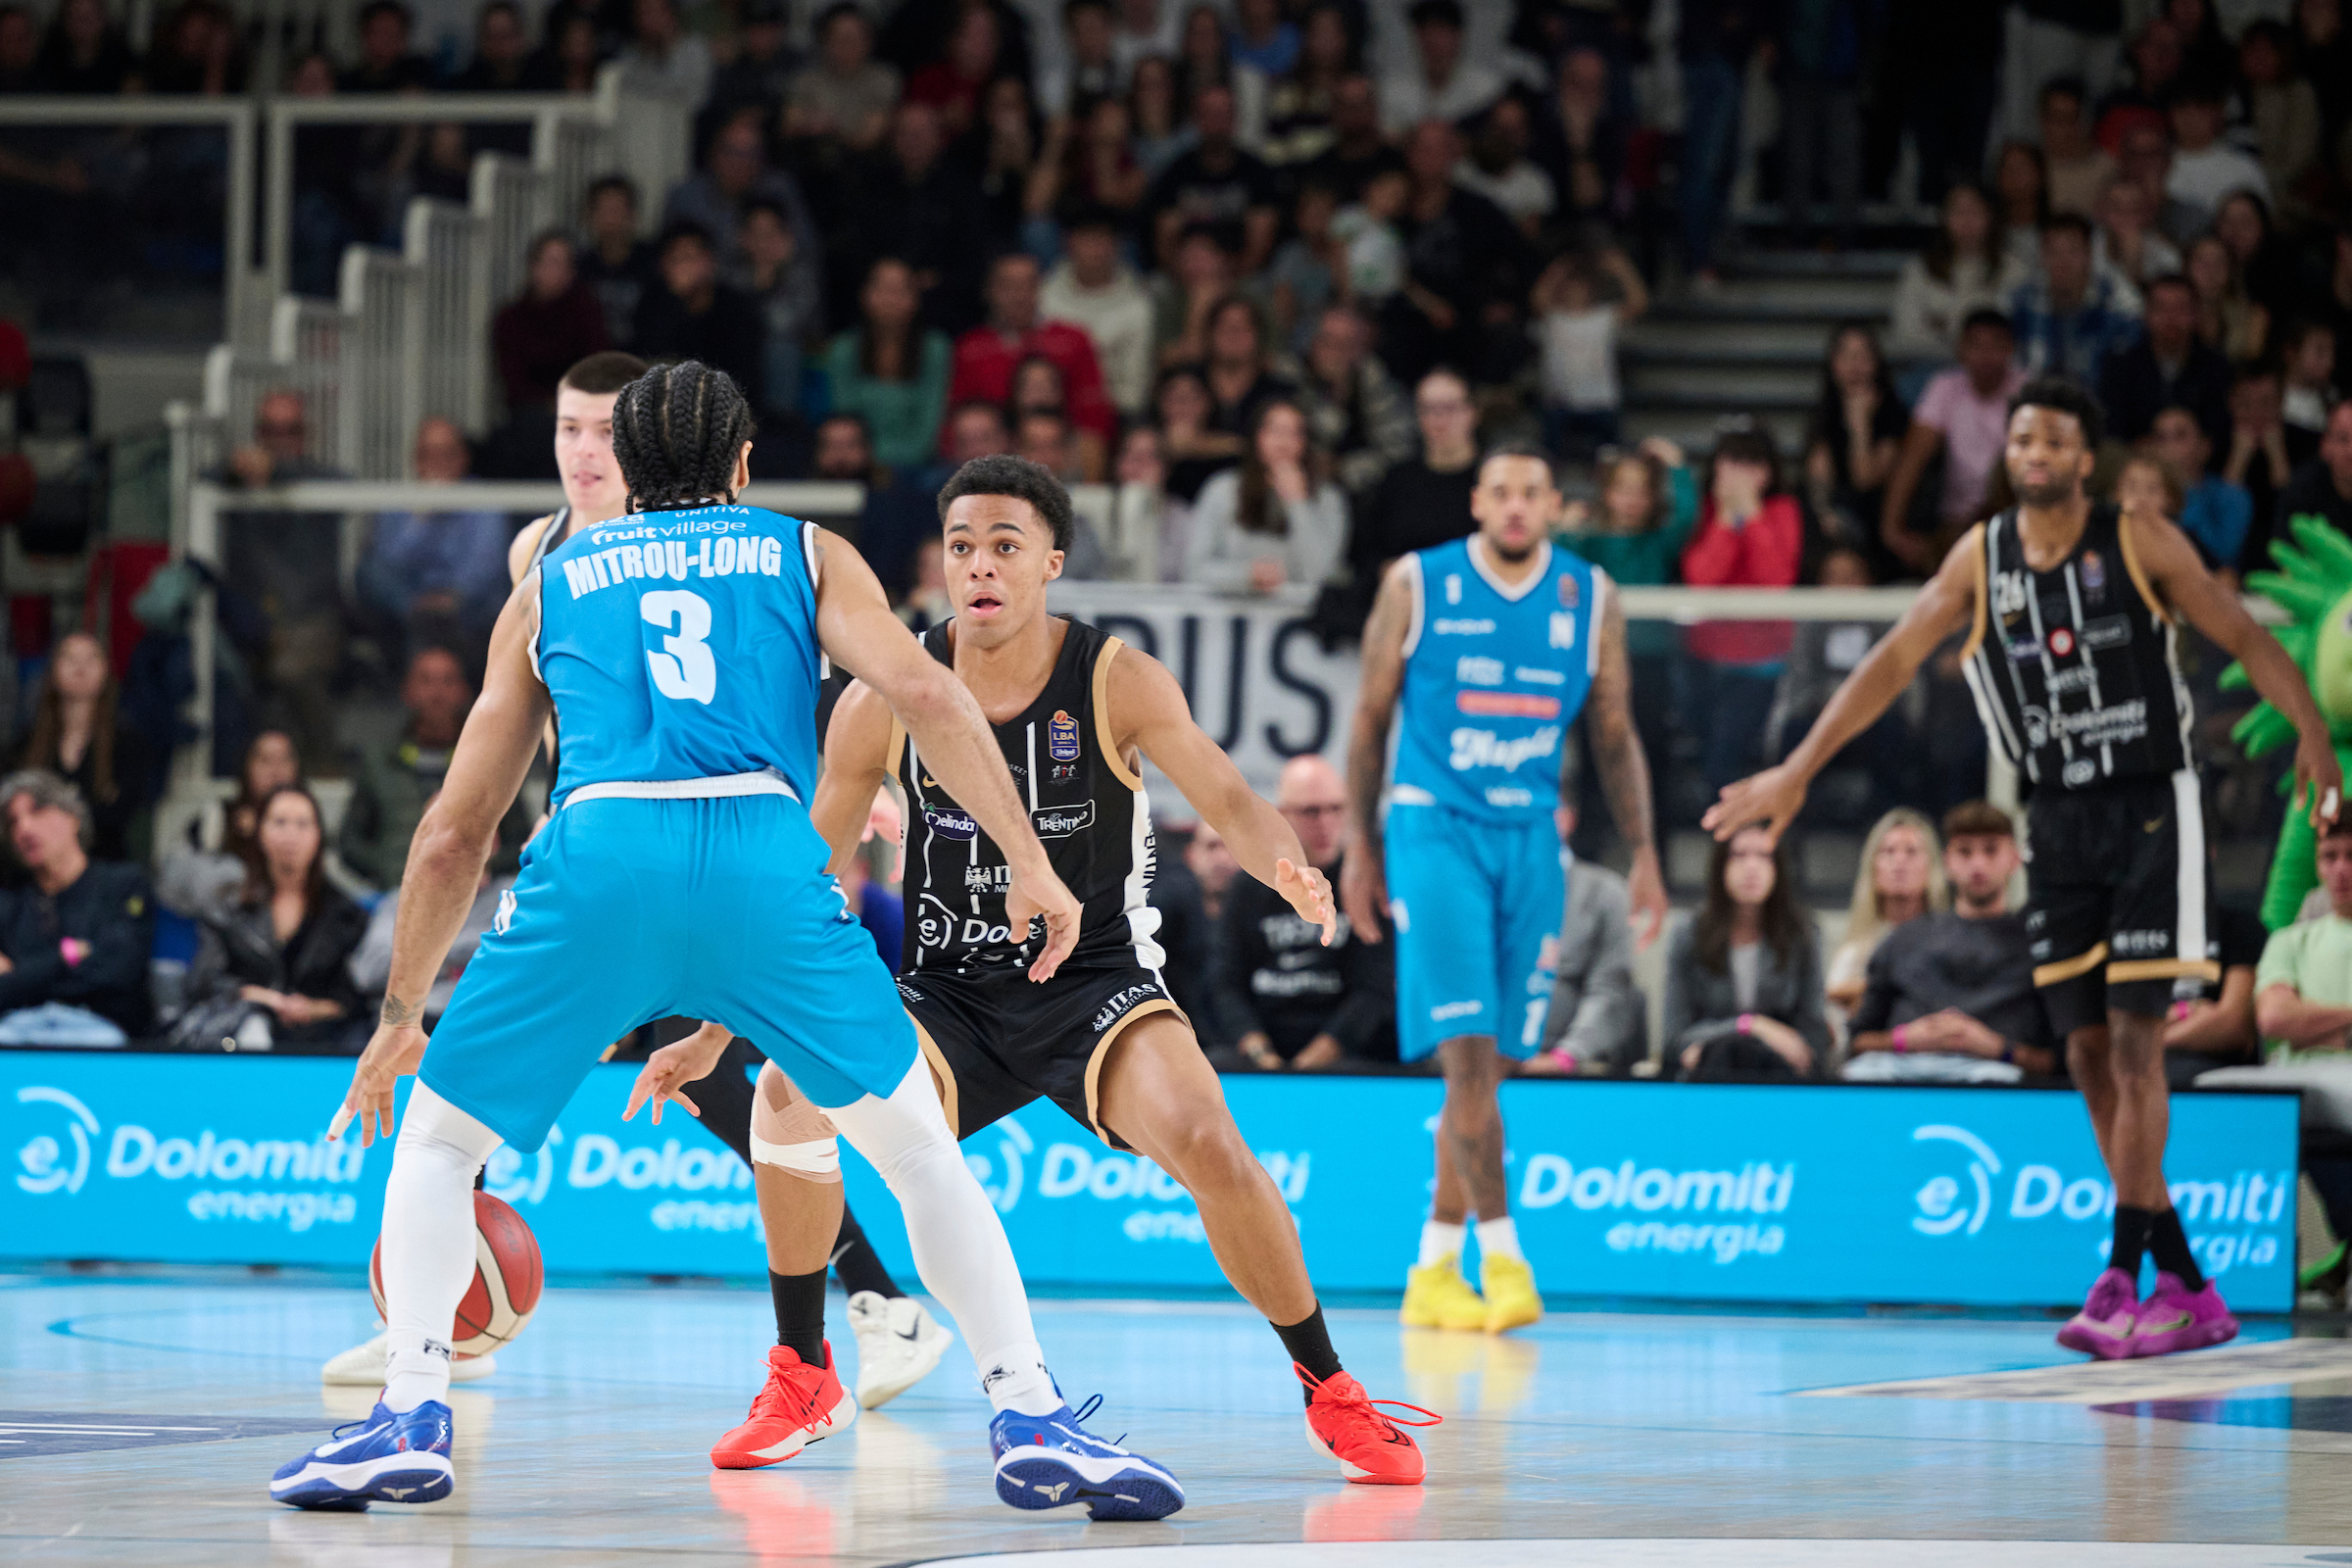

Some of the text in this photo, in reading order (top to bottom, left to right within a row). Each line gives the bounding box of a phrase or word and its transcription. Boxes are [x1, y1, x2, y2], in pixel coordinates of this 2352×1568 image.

[675, 507, 751, 518] UNITIVA
[563, 536, 783, 600] MITROU-LONG
[640, 589, 717, 705] 3
[1053, 732, 1076, 741] LBA
[925, 811, 976, 832] Melinda
[1107, 983, 1157, 1012] ITAS
[106, 1124, 366, 1183] Dolomiti
[1520, 1152, 1795, 1213] Dolomiti
[187, 1190, 357, 1232] energia
[1605, 1221, 1787, 1265] energia
